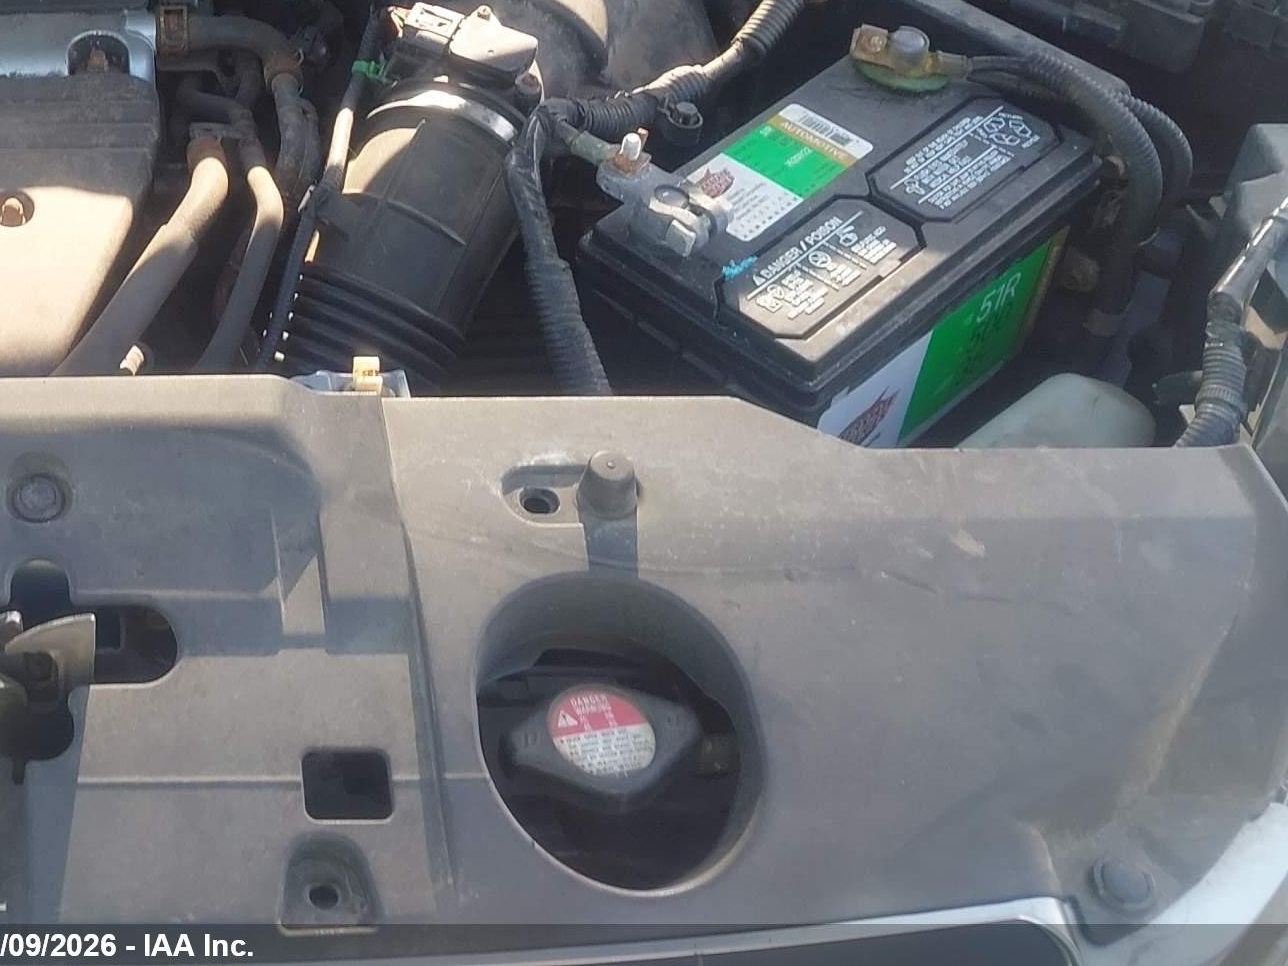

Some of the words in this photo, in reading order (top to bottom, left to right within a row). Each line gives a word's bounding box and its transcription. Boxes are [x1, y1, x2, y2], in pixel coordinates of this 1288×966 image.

[781, 120, 849, 161] AUTOMOTIVE
[760, 246, 803, 279] DANGER
[805, 216, 844, 245] POISON
[976, 271, 1022, 323] 51R
